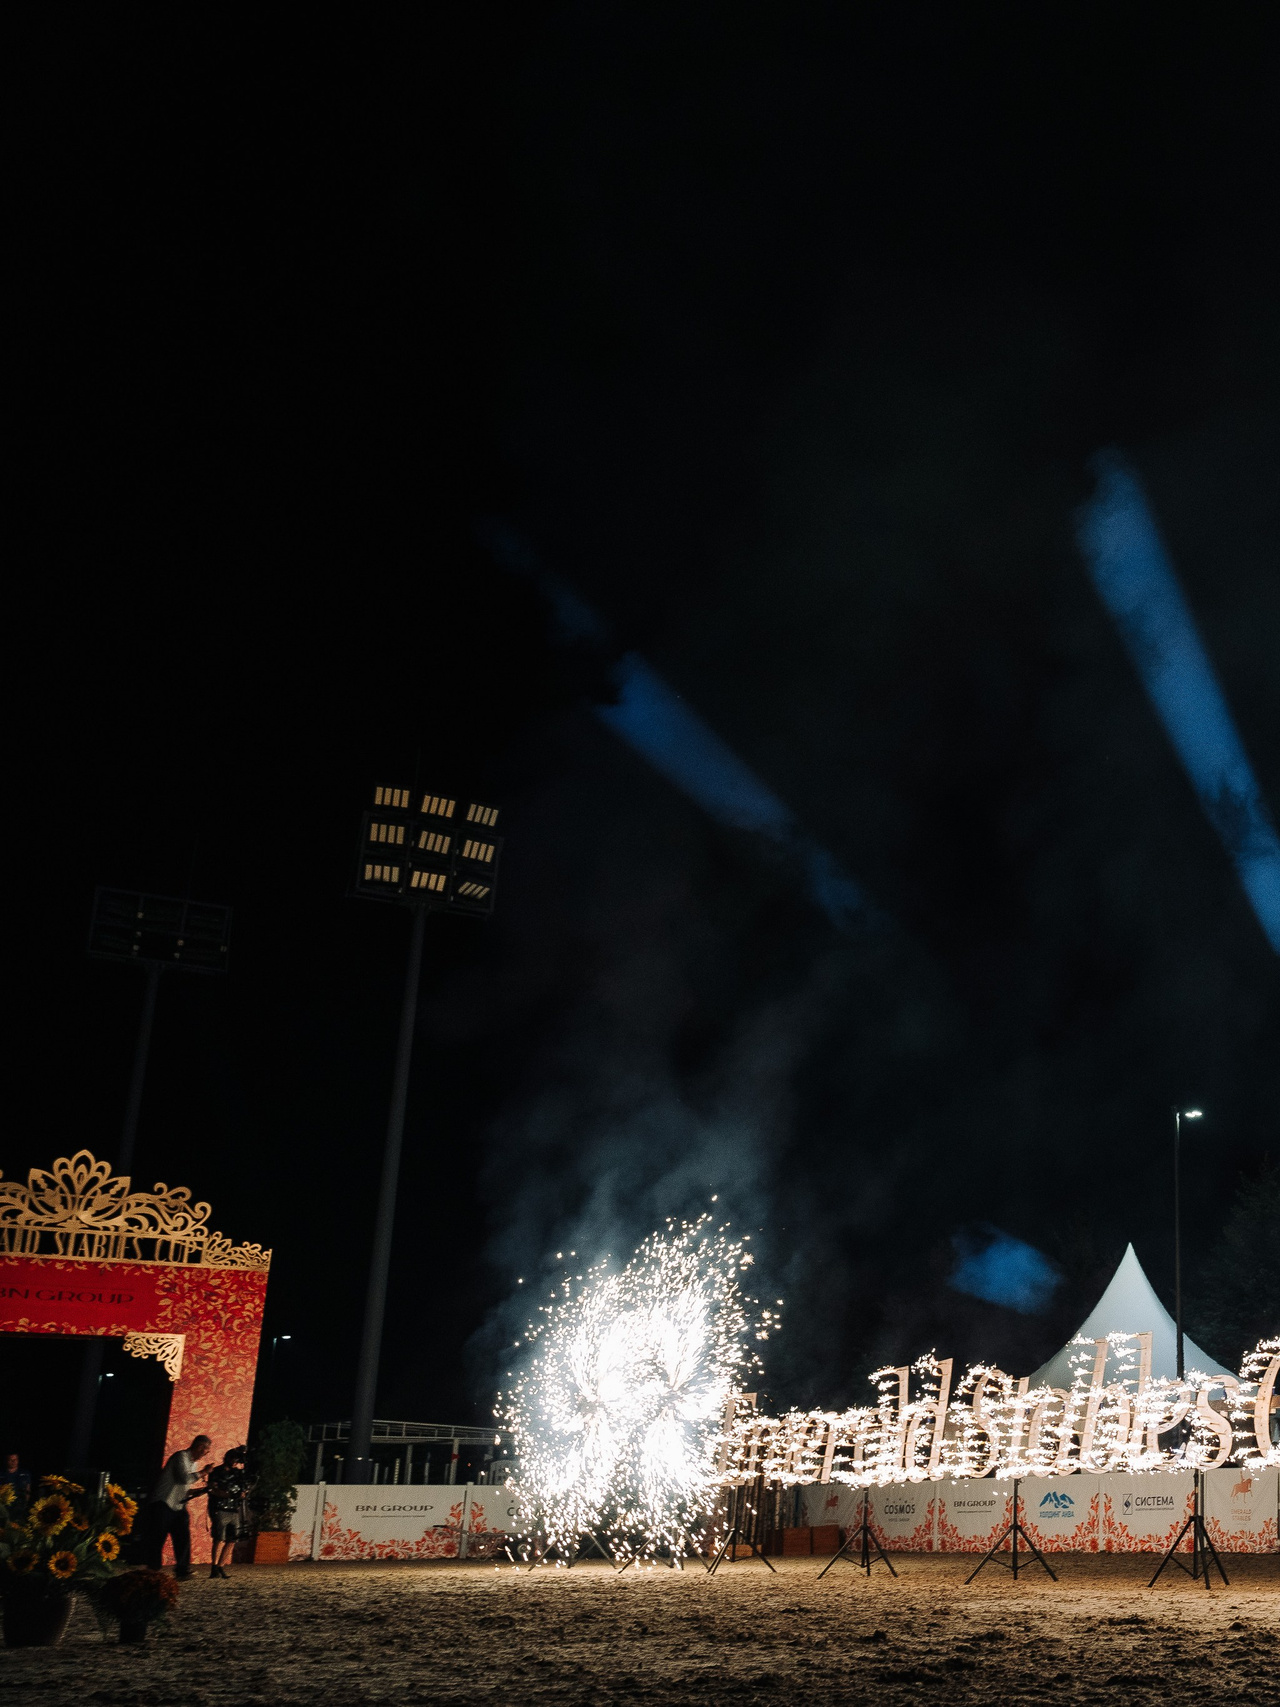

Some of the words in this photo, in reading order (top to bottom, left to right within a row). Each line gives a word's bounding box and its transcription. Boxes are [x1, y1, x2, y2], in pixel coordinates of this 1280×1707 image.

[35, 1289, 135, 1305] GROUP
[966, 1500, 997, 1508] GROUP
[1134, 1495, 1175, 1508] СИСТЕМА
[355, 1504, 377, 1512] BN
[380, 1504, 434, 1512] GROUP
[884, 1503, 916, 1515] COSMOS
